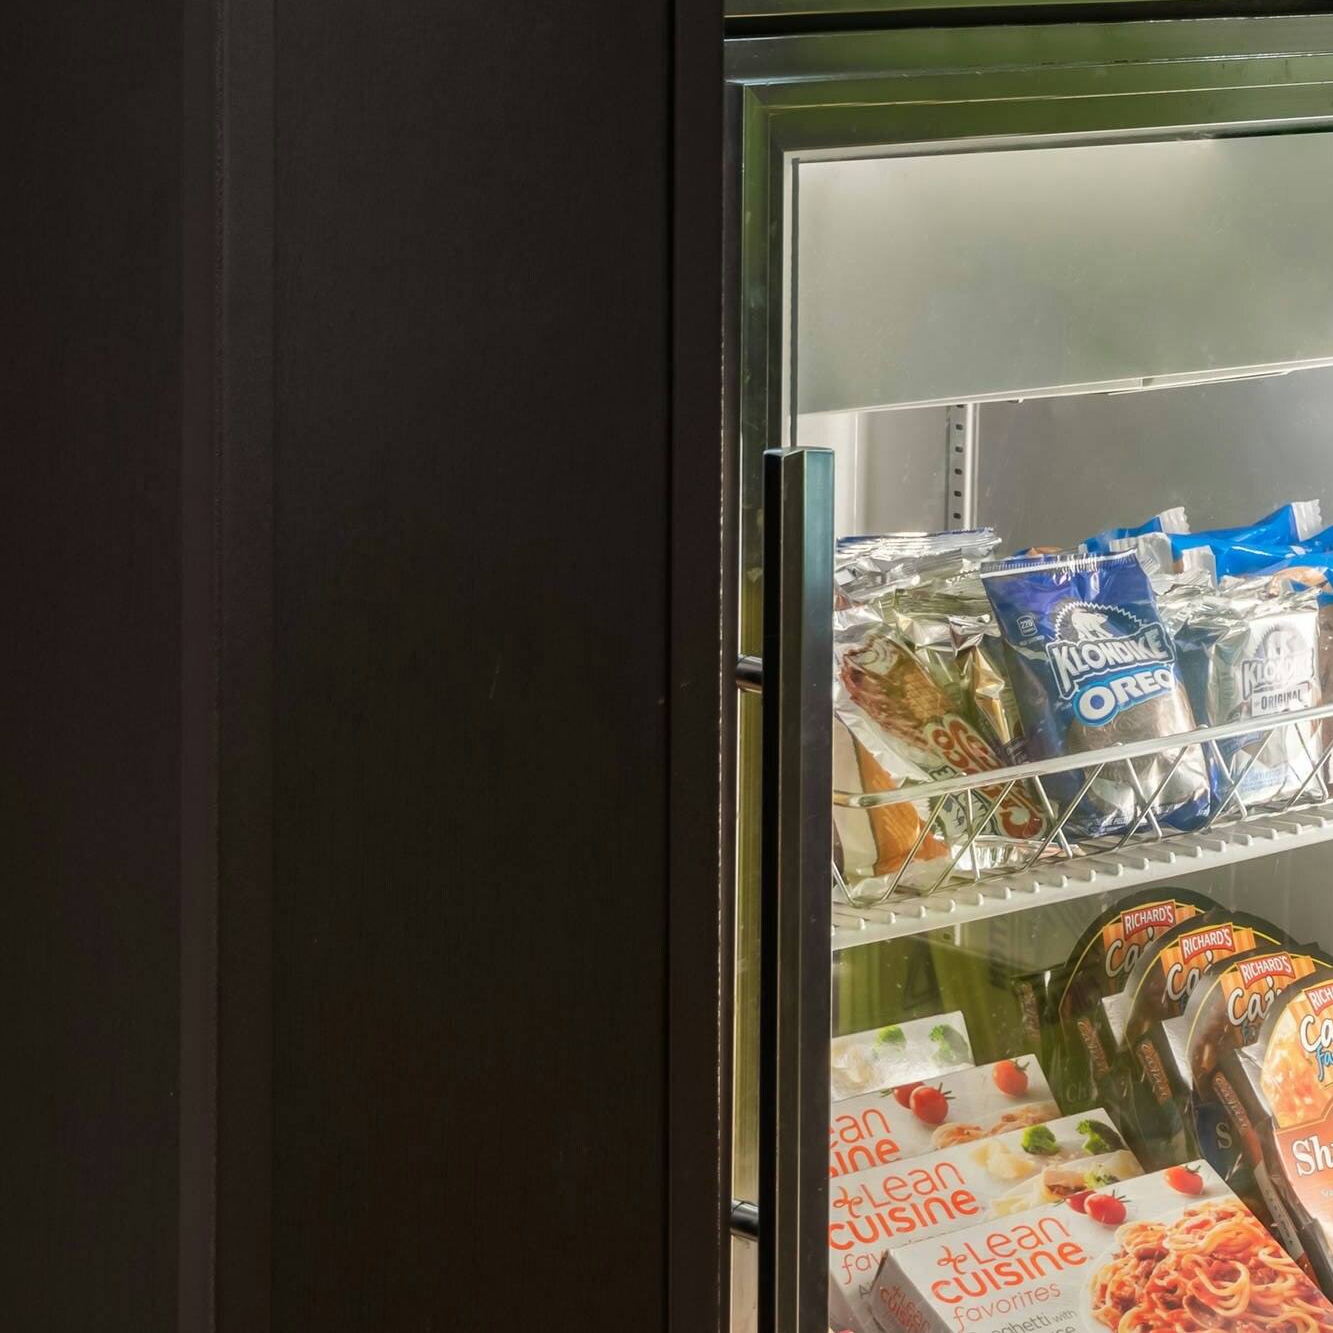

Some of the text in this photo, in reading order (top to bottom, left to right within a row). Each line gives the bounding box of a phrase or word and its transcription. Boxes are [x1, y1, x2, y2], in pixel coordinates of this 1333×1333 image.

[1050, 626, 1168, 692] KLONDIKE
[1079, 668, 1174, 721] OREO
[1260, 689, 1303, 710] ORIGINAL
[1124, 905, 1175, 935] RICHARD'S
[1181, 928, 1233, 959] RICHARD'S
[1241, 955, 1292, 981] RICHARD'S
[860, 1162, 966, 1209] Lean
[963, 1216, 1071, 1265] Lean
[953, 1282, 1062, 1331] favorites
